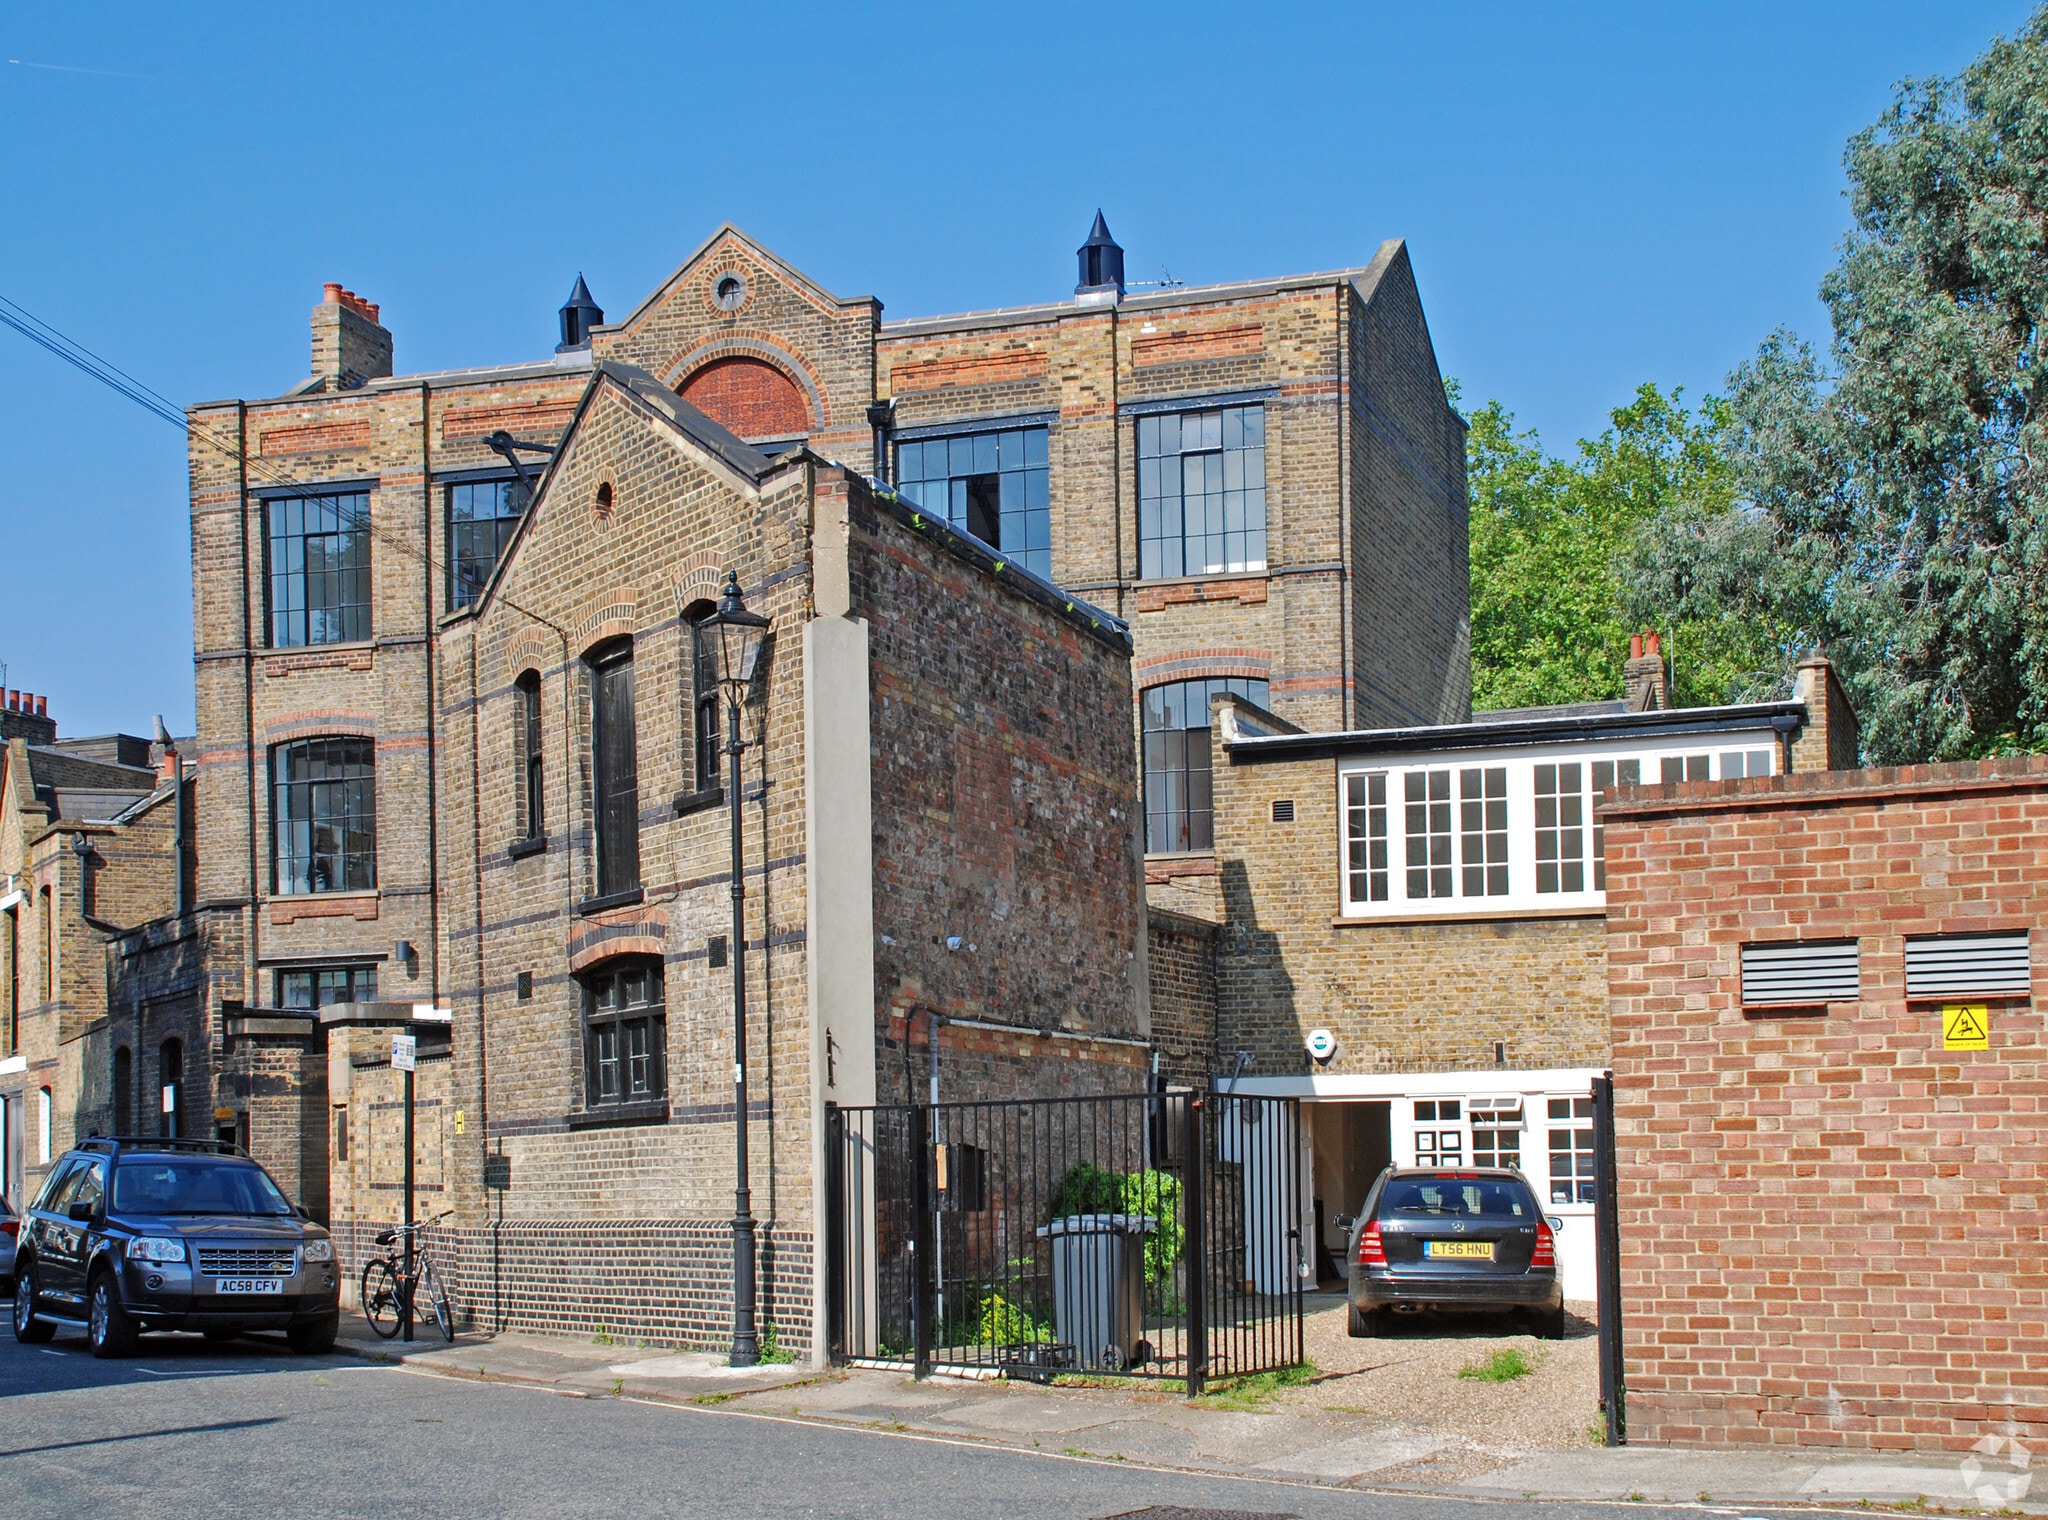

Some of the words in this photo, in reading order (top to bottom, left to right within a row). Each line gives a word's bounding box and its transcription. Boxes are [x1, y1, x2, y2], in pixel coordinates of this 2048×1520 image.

[1432, 1243, 1463, 1255] LT56
[1467, 1243, 1490, 1255] HNU
[222, 1280, 252, 1291] AC58
[255, 1280, 277, 1291] CFV
